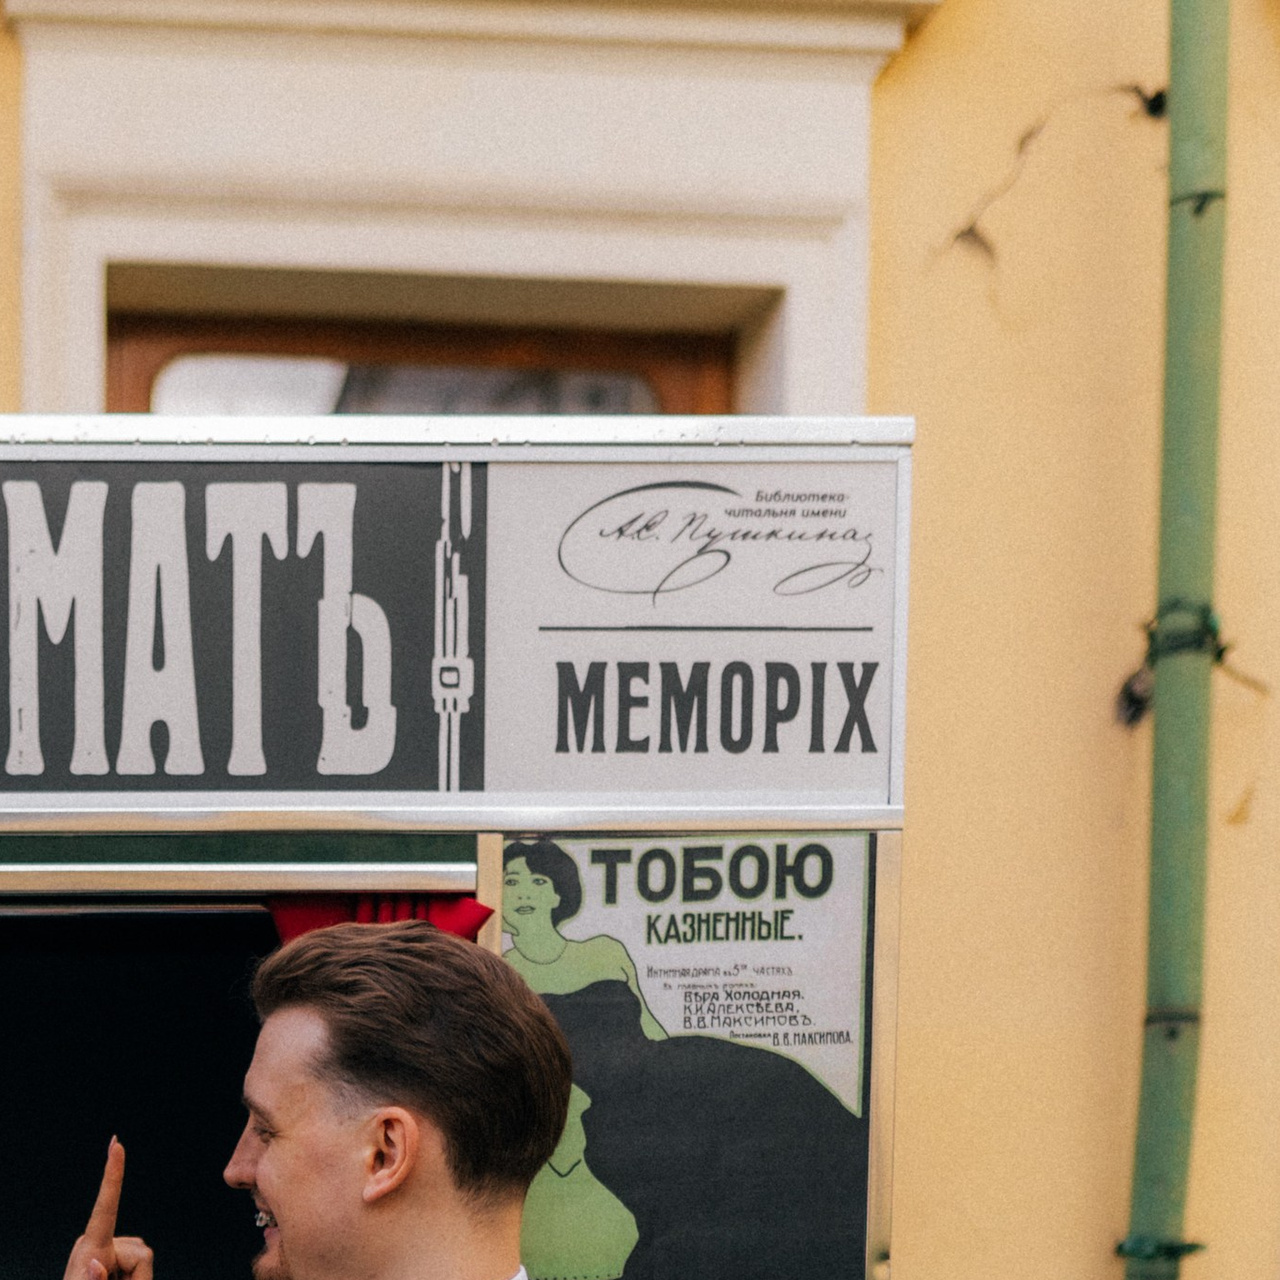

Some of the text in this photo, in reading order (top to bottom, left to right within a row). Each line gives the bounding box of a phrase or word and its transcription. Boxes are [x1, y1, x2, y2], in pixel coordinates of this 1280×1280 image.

[724, 507, 847, 518] читальня имени
[590, 843, 834, 905] ТОБОЮ
